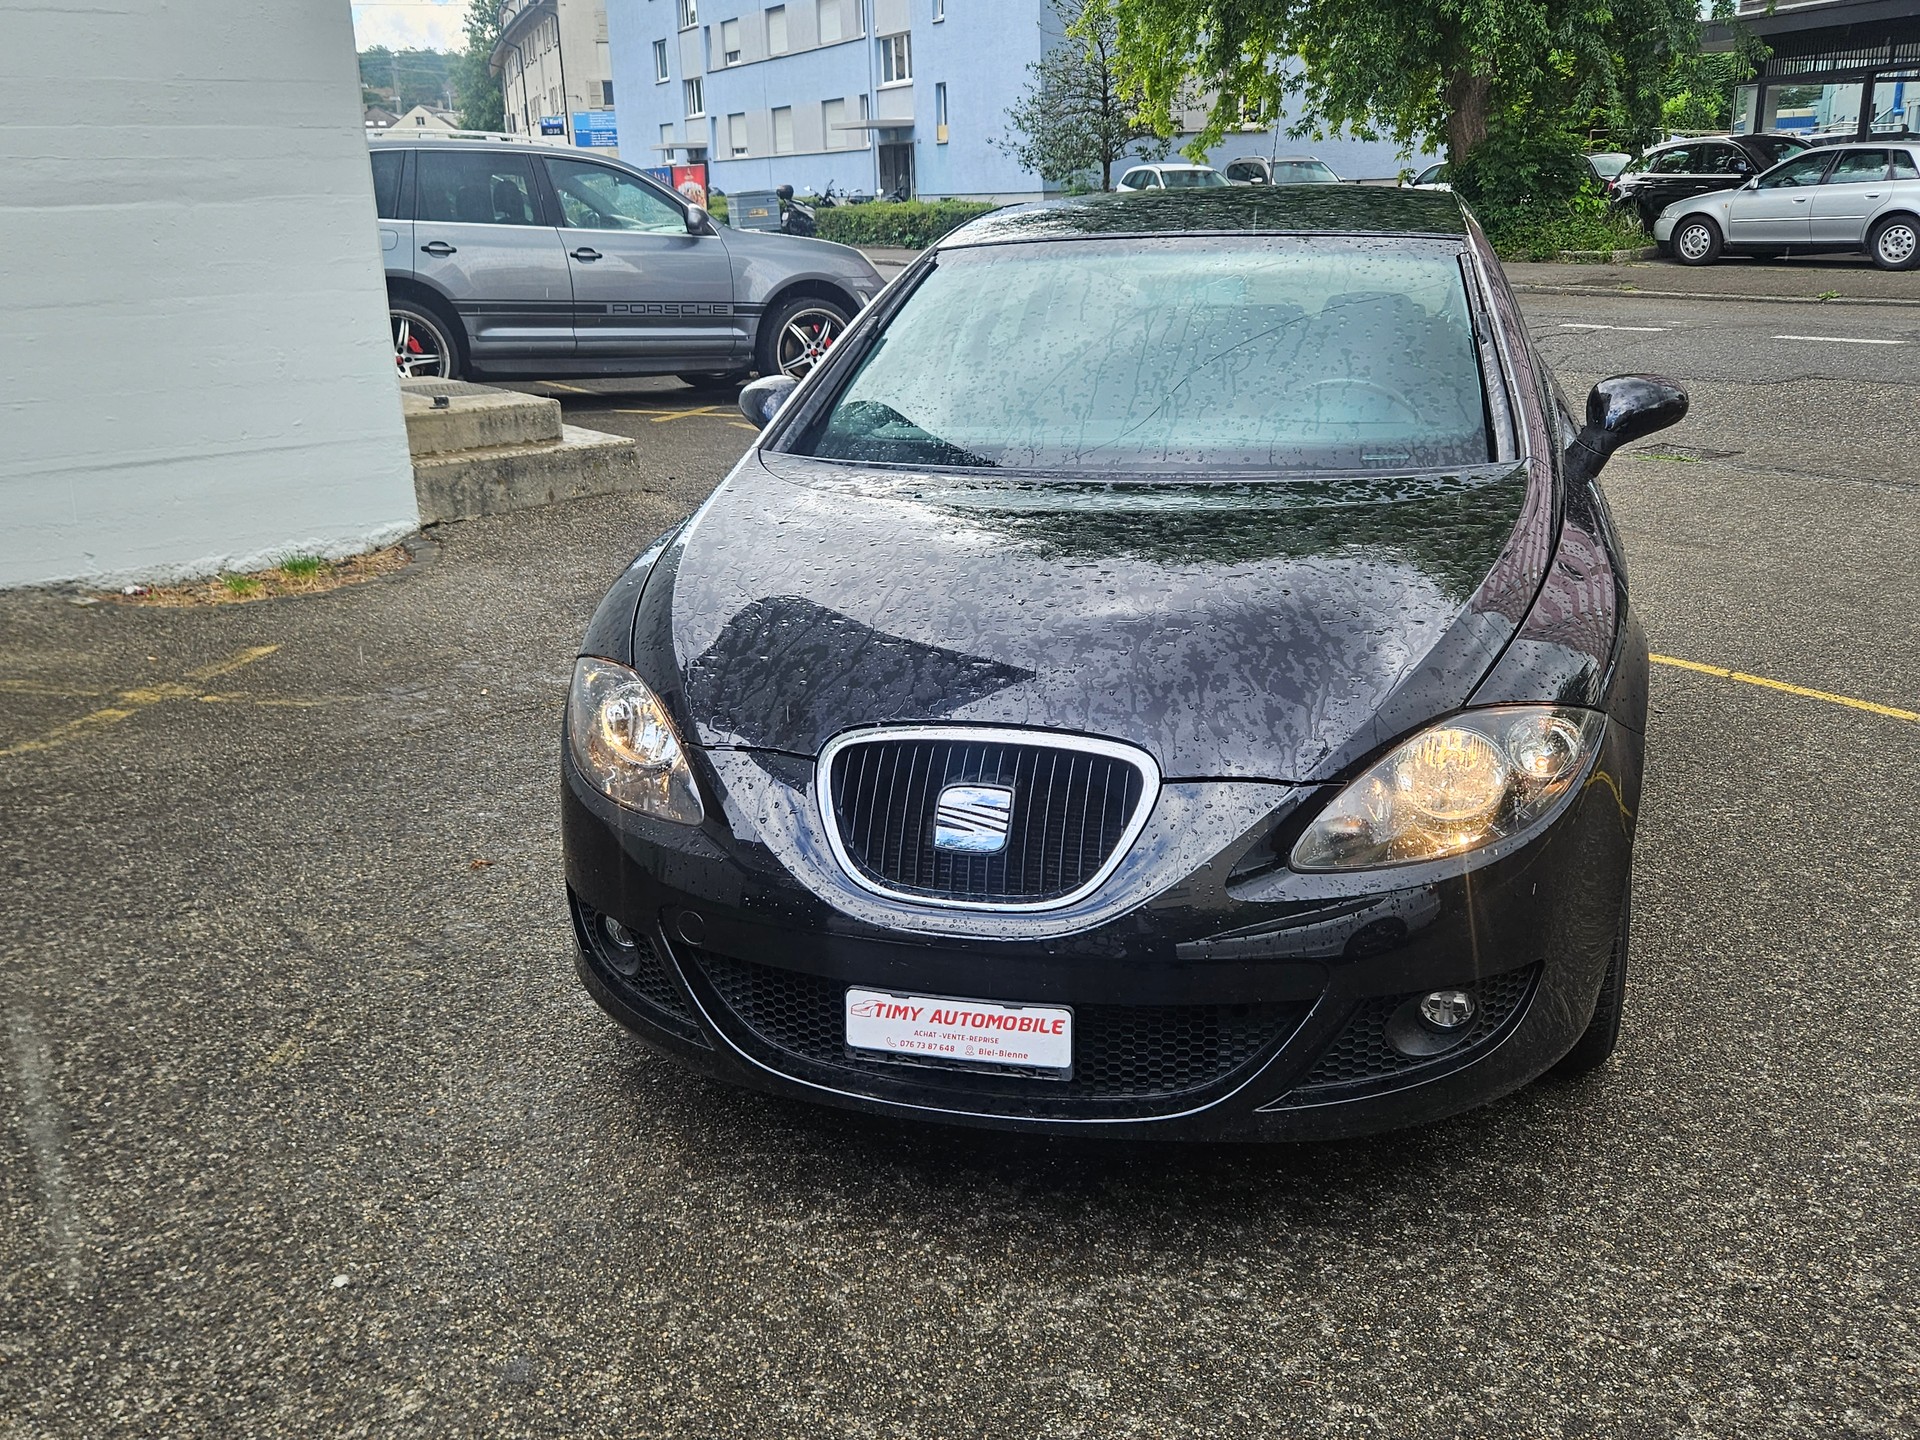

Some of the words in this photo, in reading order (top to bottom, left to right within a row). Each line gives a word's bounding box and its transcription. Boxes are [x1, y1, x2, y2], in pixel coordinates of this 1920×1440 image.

[612, 304, 728, 314] PORSCHE
[875, 1003, 924, 1021] TIMY
[929, 1009, 1066, 1035] AUTOMOBILE
[914, 1030, 937, 1038] ACHAT
[900, 1040, 914, 1048] 076
[916, 1041, 925, 1049] 73
[928, 1042, 937, 1050] 87
[939, 1043, 955, 1052] 648
[978, 1047, 1029, 1059] Biel-Bienne
